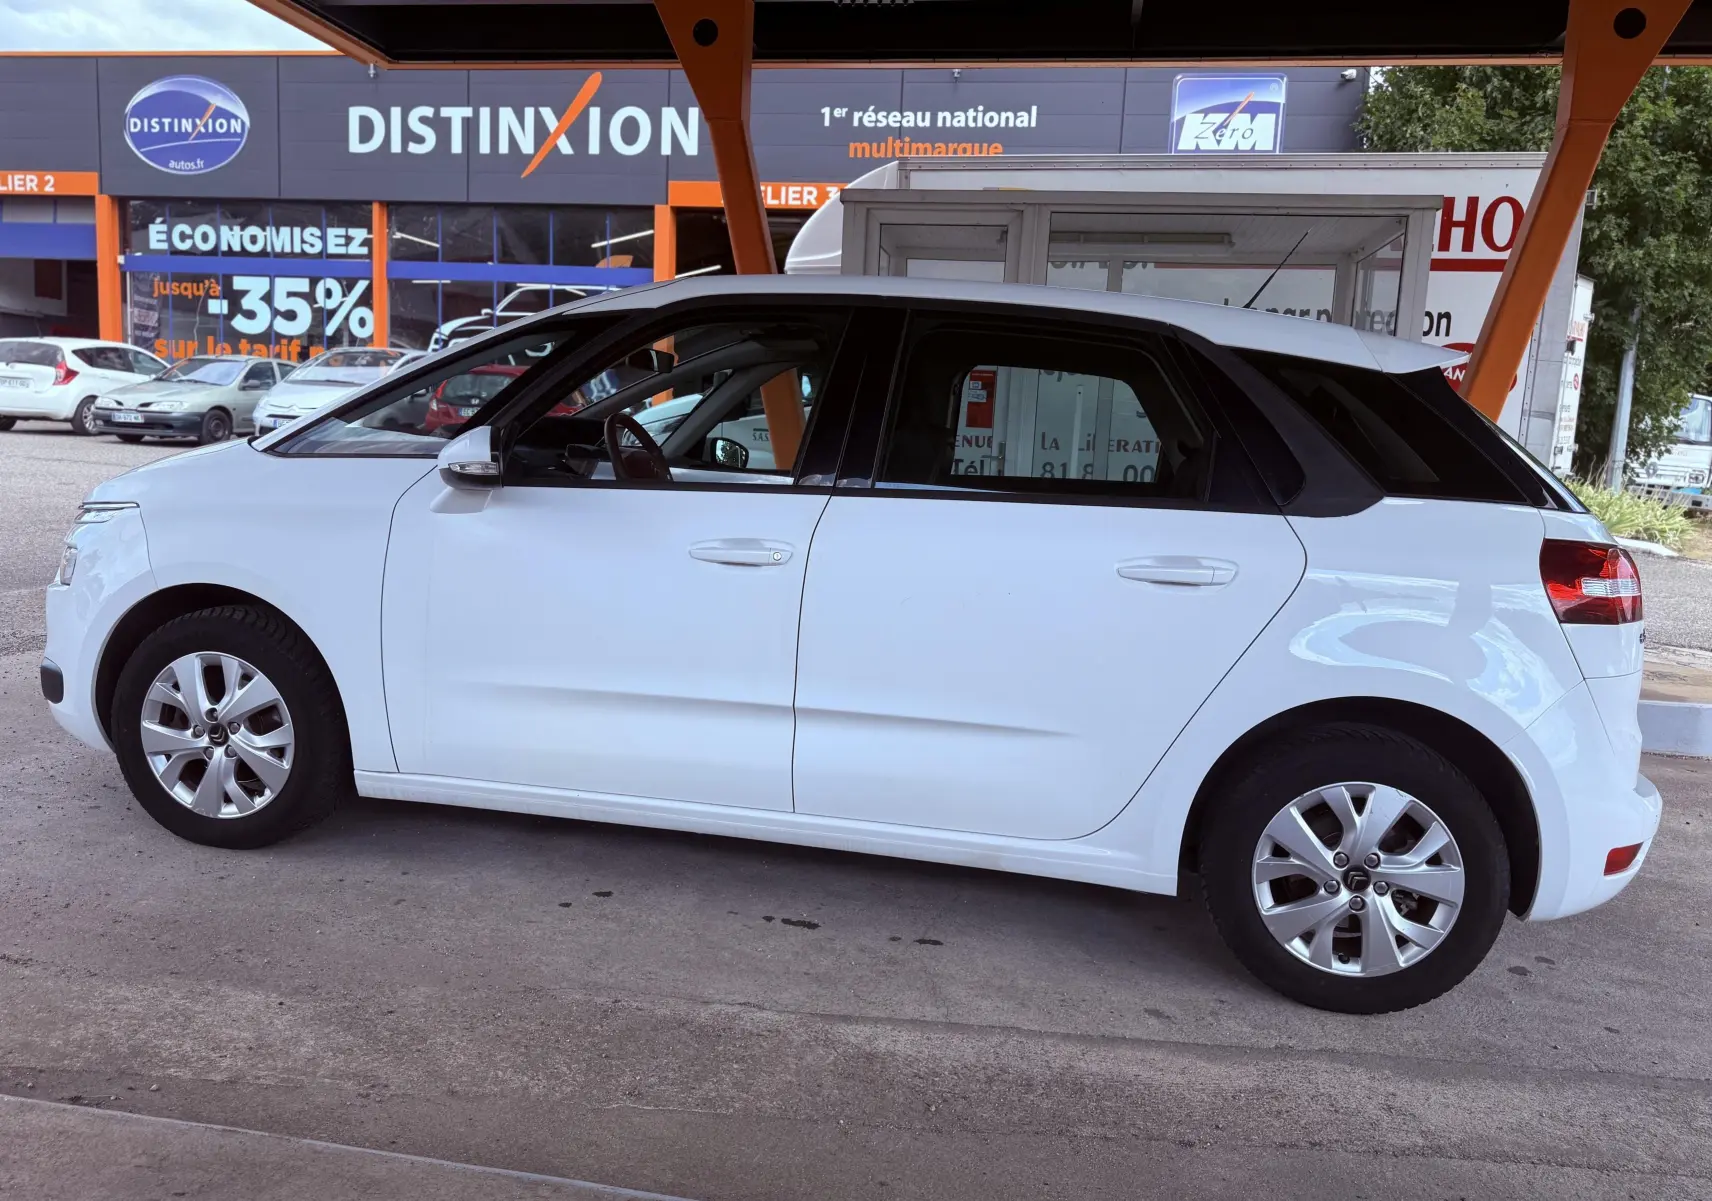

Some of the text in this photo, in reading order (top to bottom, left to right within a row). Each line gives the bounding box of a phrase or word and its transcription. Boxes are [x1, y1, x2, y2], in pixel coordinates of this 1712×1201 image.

[348, 72, 700, 178] DISTINXION
[820, 105, 1038, 128] 1er réseau national
[1194, 121, 1254, 141] Zero
[849, 137, 1003, 158] multimarque
[168, 158, 205, 170] autos.fr
[44, 174, 55, 192] 2
[148, 217, 369, 255] ÉCONOMISEZ
[153, 278, 221, 299] jusqu'à
[154, 337, 198, 359] sur
[207, 336, 232, 357] le
[239, 336, 301, 362] tarif
